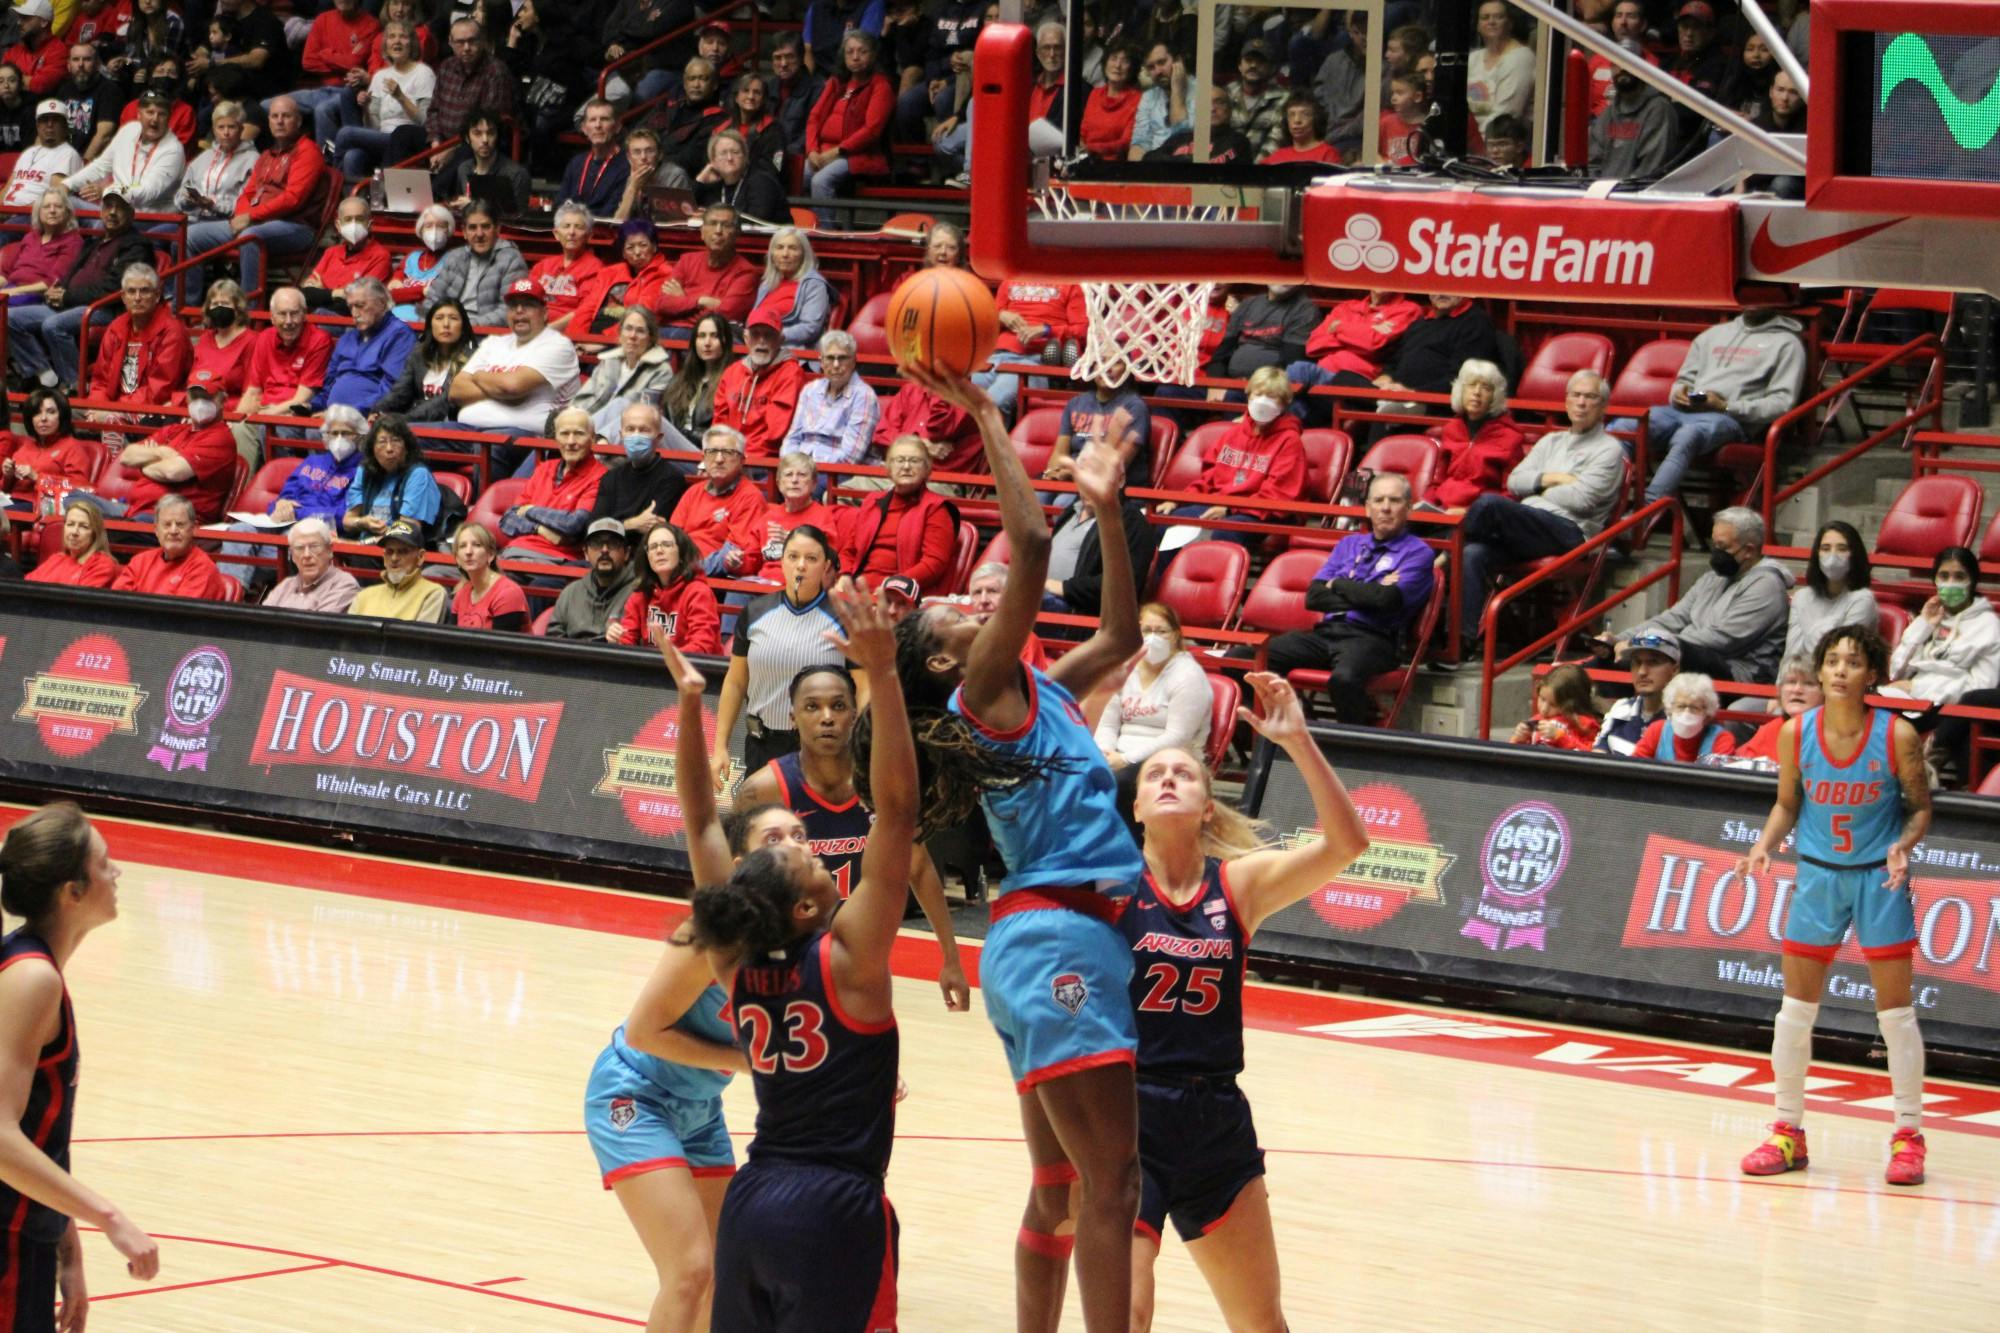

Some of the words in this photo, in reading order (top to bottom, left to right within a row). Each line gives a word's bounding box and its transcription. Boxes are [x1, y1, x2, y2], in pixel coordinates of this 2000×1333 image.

[75, 652, 113, 672] 2022
[327, 656, 365, 682] Shop
[368, 662, 423, 687] Smart,
[427, 668, 459, 693] Buy
[461, 671, 524, 698] Smart...
[85, 702, 126, 718] CHOICE
[51, 723, 94, 741] WINNER
[159, 732, 208, 751] WINNER
[268, 686, 549, 784] HOUSTON
[316, 772, 392, 801] Wholesale
[394, 783, 431, 806] Cars
[434, 789, 472, 811] LLC
[1806, 779, 1885, 807] LOBOS
[807, 836, 869, 856] ARIZON
[1720, 820, 1757, 845] Sho
[1831, 813, 1853, 854] 5
[831, 860, 852, 900] 1
[1371, 865, 1427, 884] CHOICE
[1324, 890, 1384, 911] WINNER
[1477, 901, 1543, 926] WINNER
[1132, 932, 1233, 960] ARIZONA
[1717, 959, 1784, 989] Whole
[1137, 962, 1223, 1016] 25
[738, 1000, 830, 1075] 23
